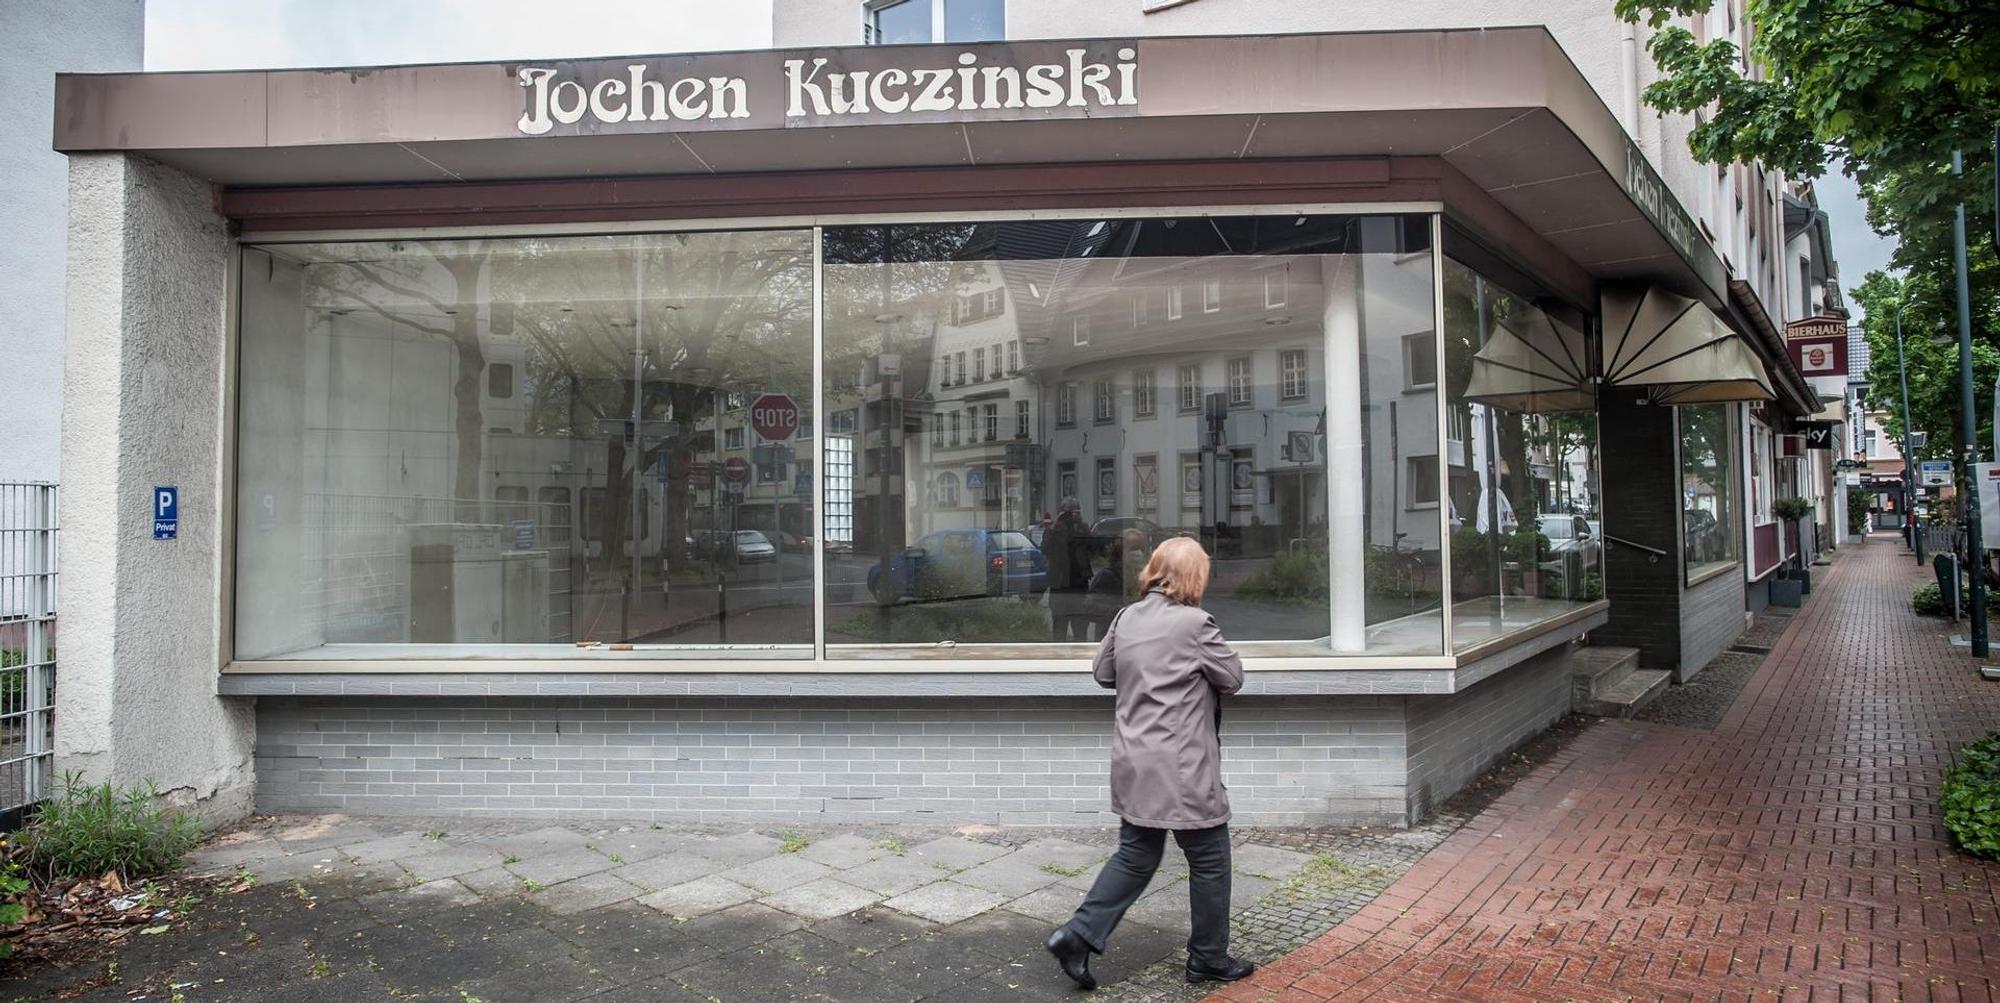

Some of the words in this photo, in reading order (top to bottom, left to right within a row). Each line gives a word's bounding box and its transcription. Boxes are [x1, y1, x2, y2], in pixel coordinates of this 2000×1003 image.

[517, 63, 751, 135] Jochen
[783, 47, 1138, 117] Kuczinski
[1787, 323, 1847, 337] BIERHAUS
[159, 491, 173, 516] P
[155, 522, 176, 532] Privat
